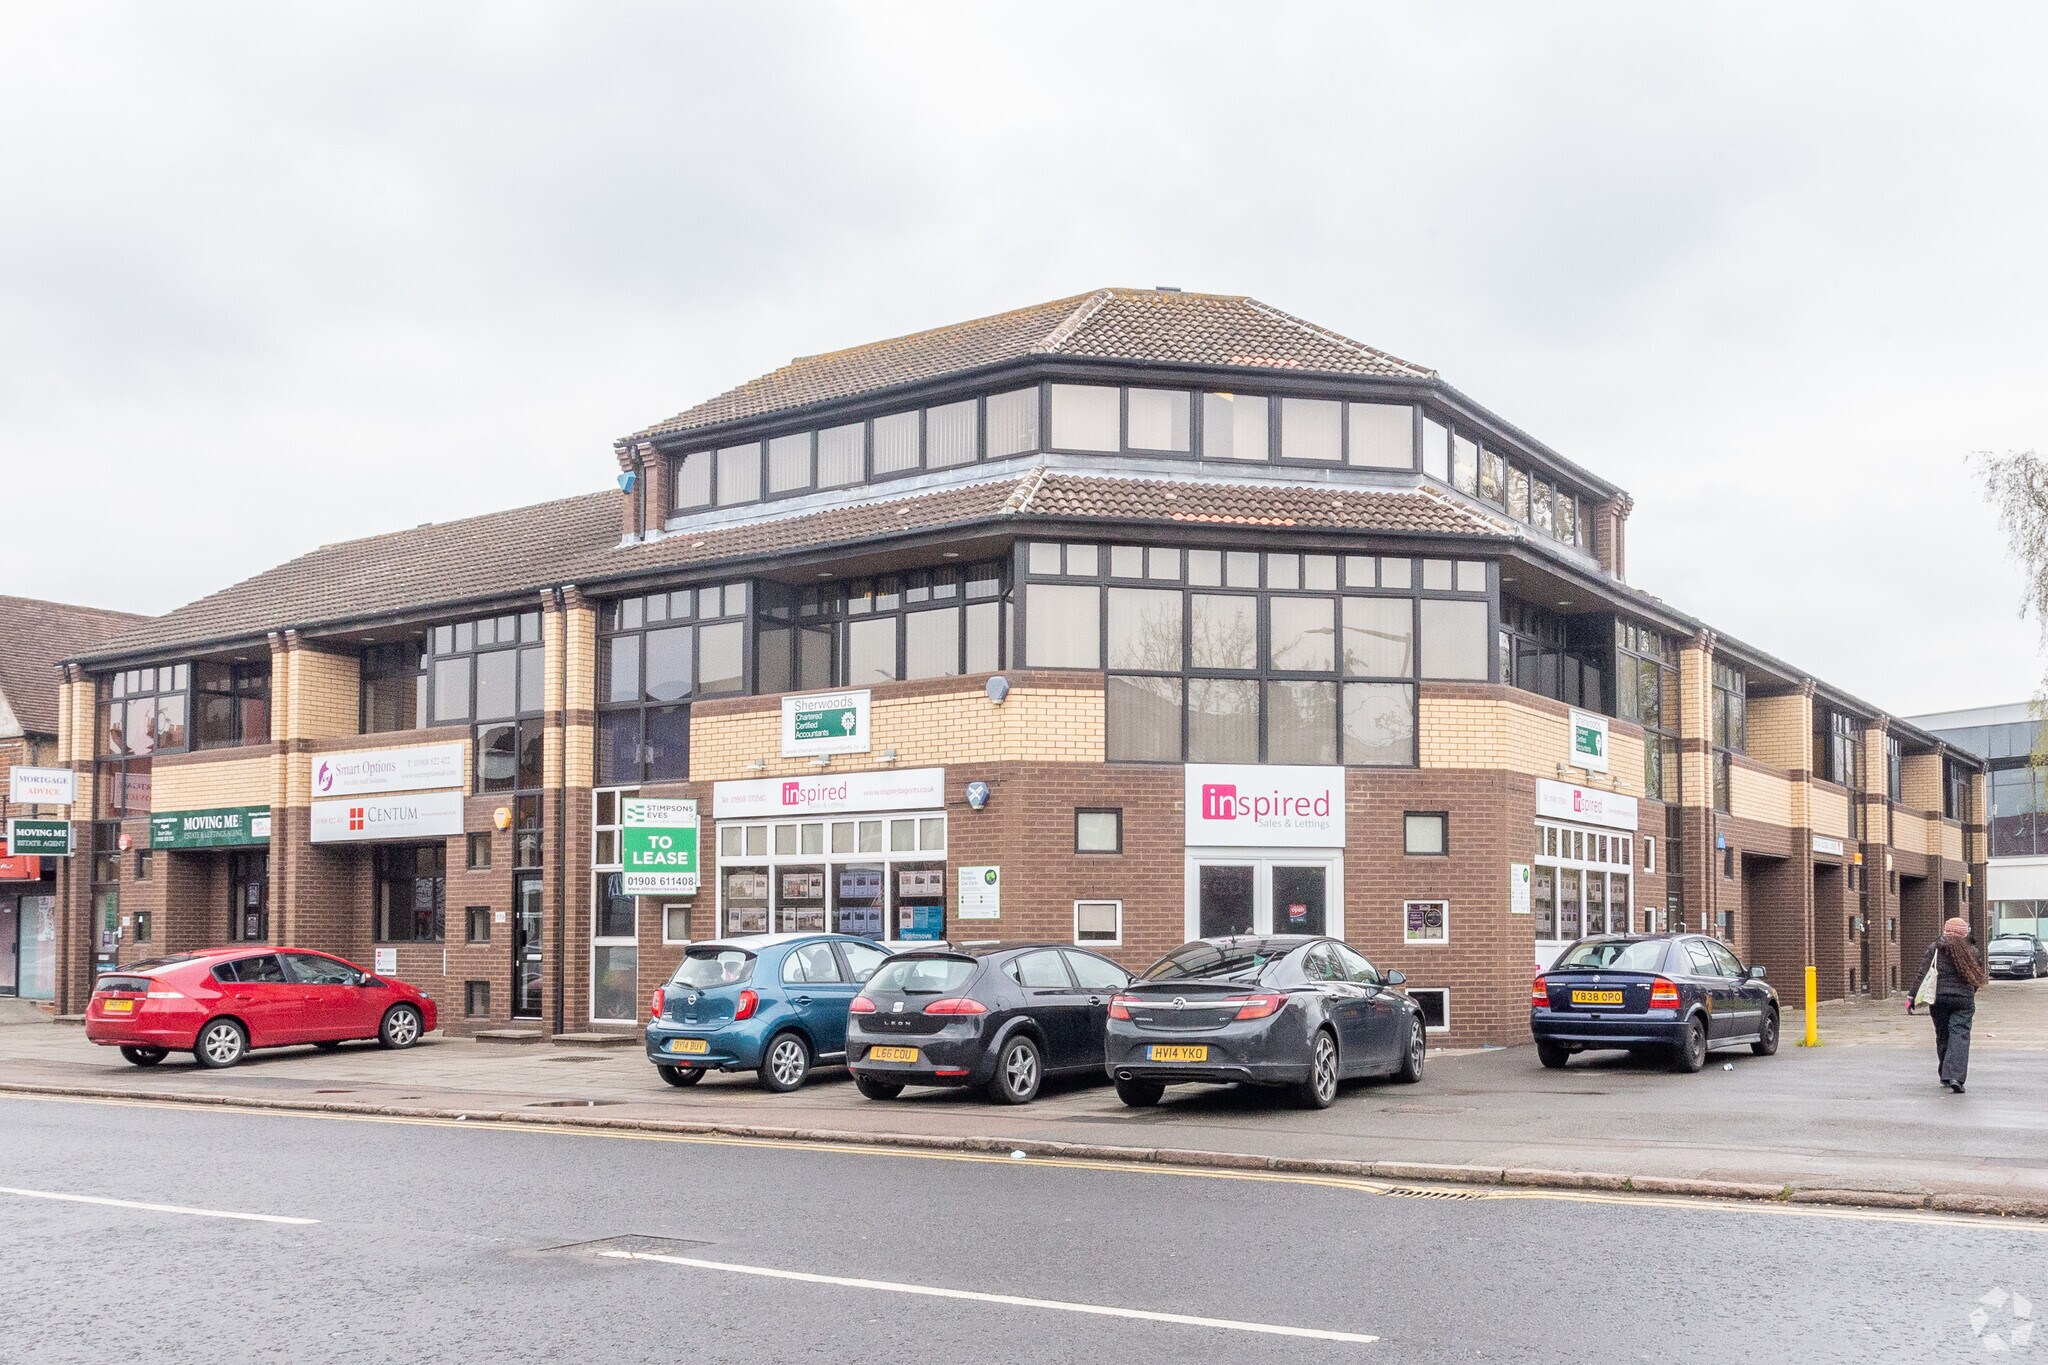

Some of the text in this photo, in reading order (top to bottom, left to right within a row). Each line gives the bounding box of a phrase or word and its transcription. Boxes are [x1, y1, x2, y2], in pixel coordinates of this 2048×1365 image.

[794, 696, 853, 711] Sherwoods
[795, 712, 823, 721] Chartered
[795, 721, 818, 730] Certified
[795, 729, 829, 738] Accountants
[335, 760, 397, 776] Smart Options
[19, 776, 69, 784] MORTGAGE
[28, 787, 60, 795] ADVICE
[783, 781, 847, 806] inspired
[1206, 785, 1330, 822] inspired
[1574, 790, 1603, 814] inspired
[367, 806, 418, 822] CENTUM
[183, 816, 222, 830] MOVING
[223, 815, 239, 828] ME
[1259, 819, 1330, 830] Sales & Lettings
[16, 829, 67, 837] MOVING ME
[648, 835, 673, 849] TO
[632, 851, 689, 865] LEASE
[628, 876, 694, 886] 01908 611408
[1574, 992, 1600, 1001] Y838
[876, 1047, 893, 1058] L66
[1155, 1048, 1203, 1059] HV14 YKO
